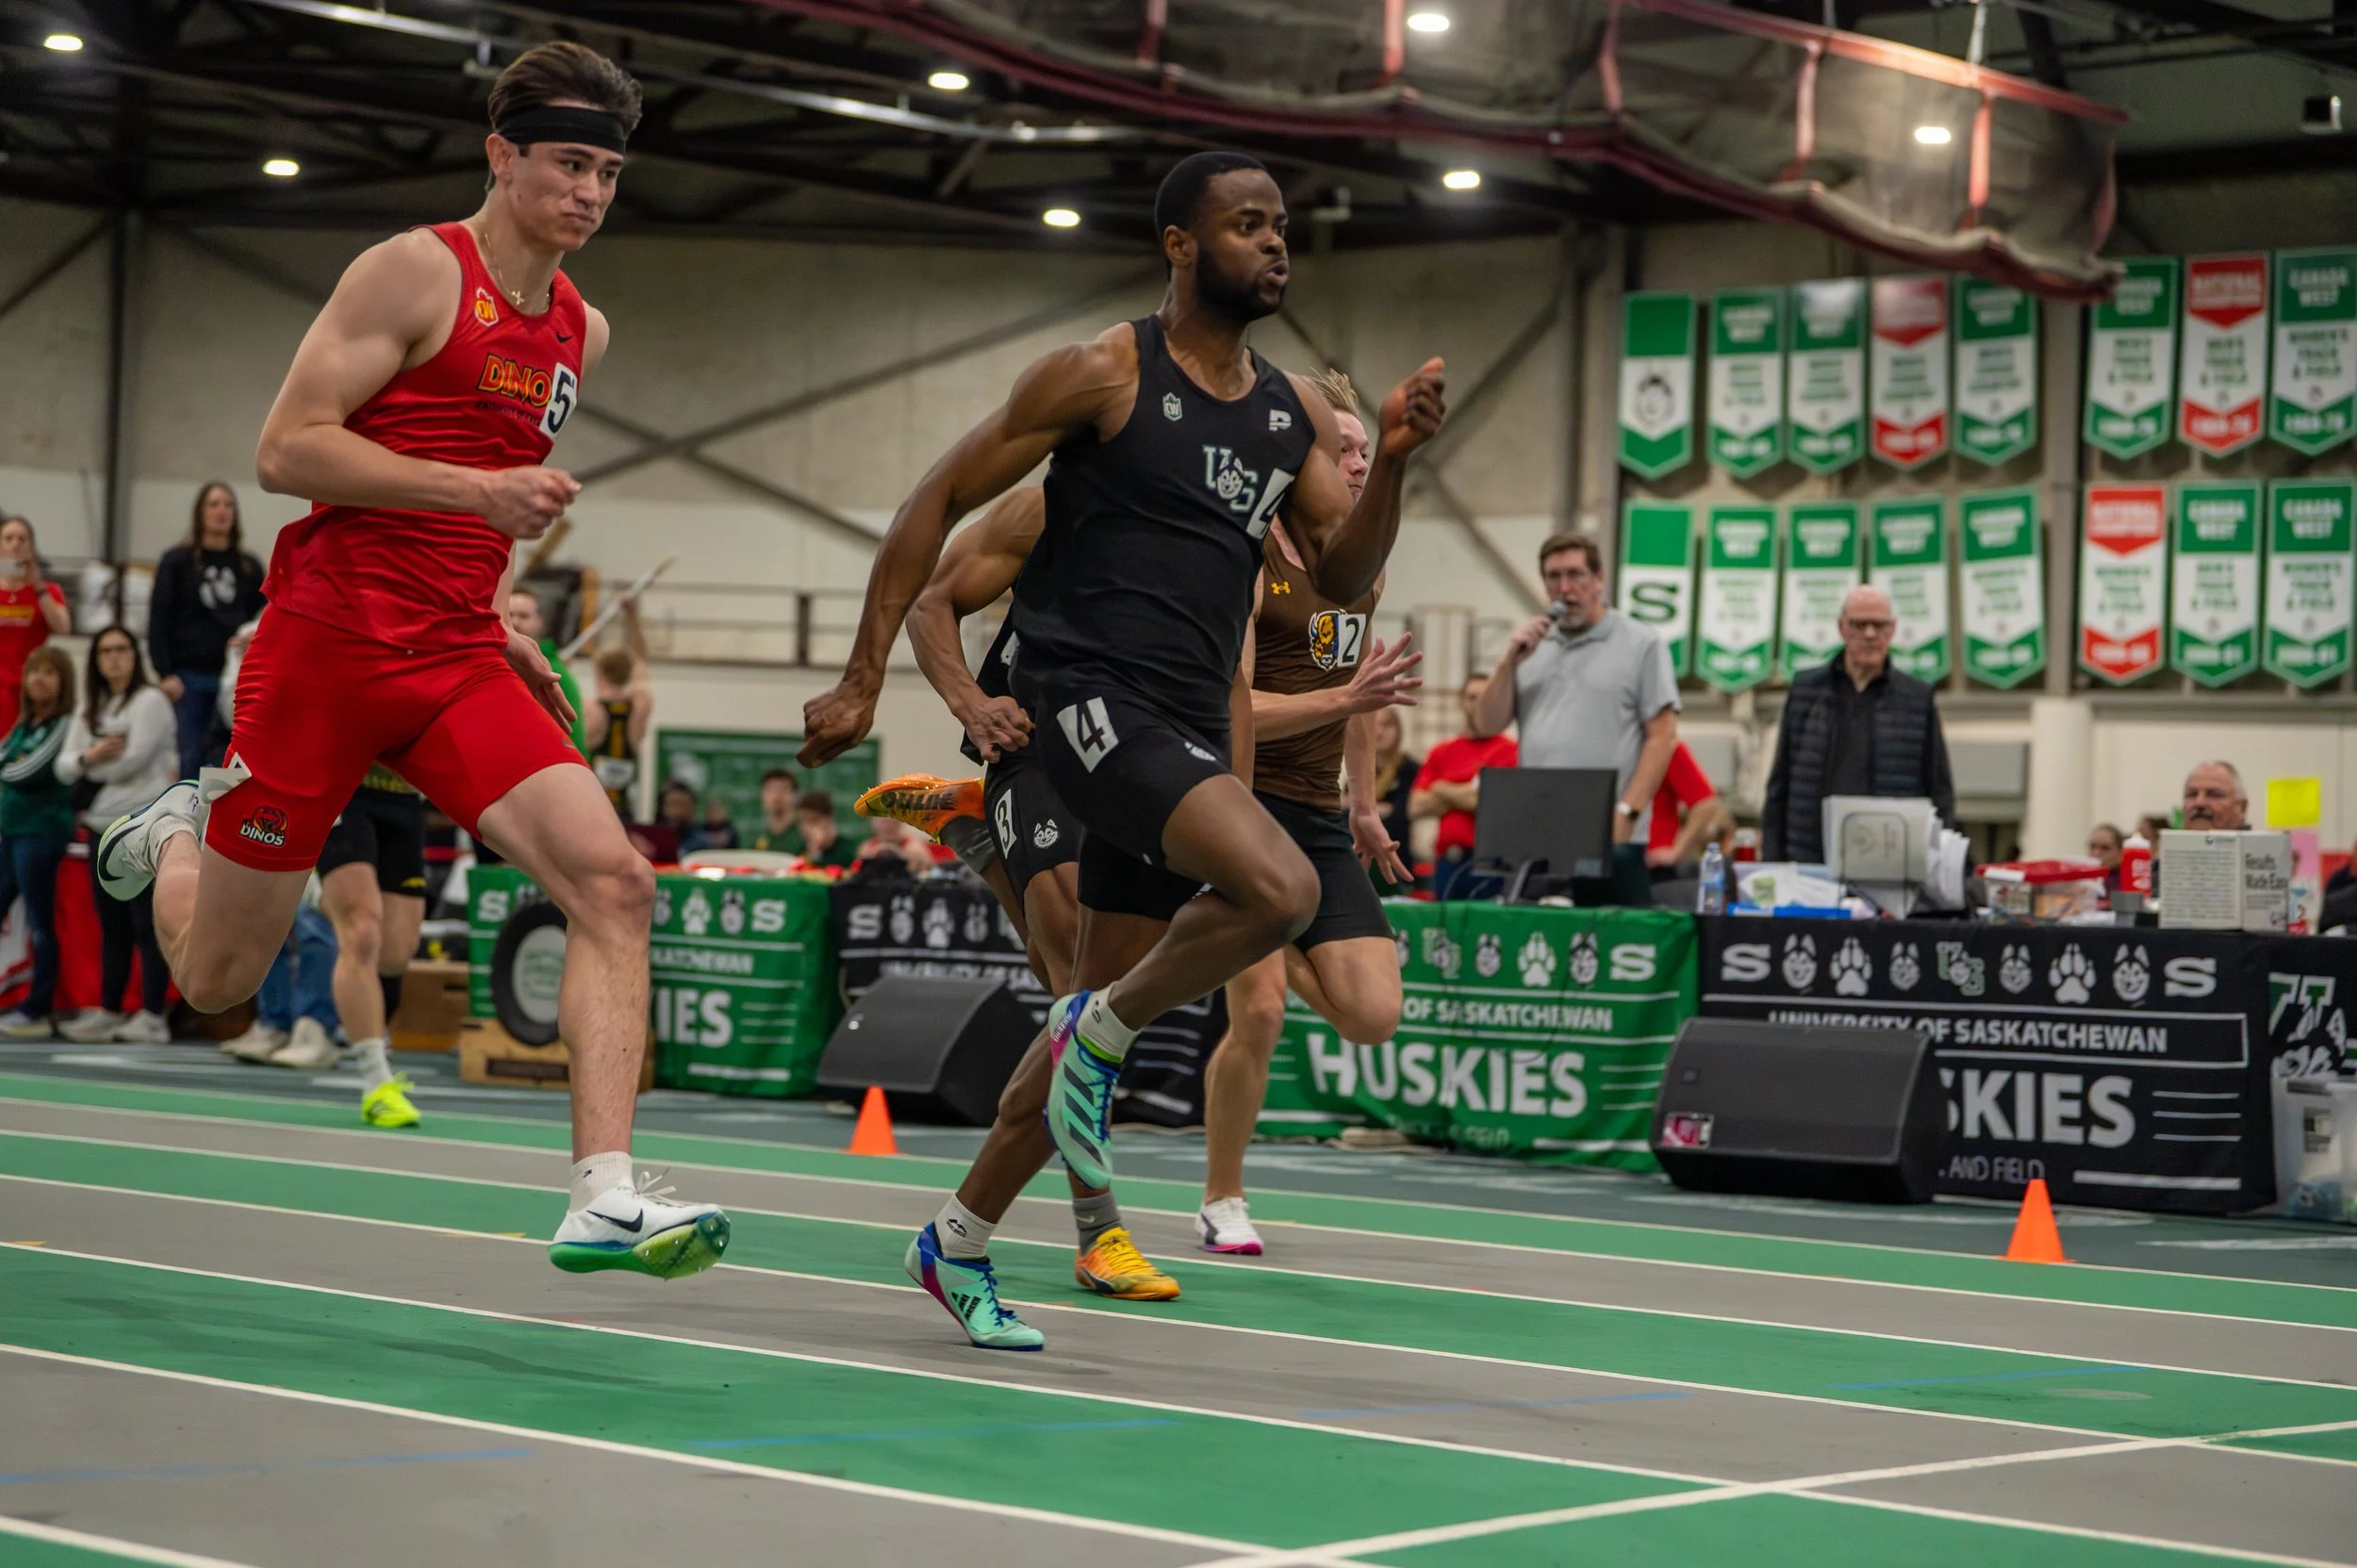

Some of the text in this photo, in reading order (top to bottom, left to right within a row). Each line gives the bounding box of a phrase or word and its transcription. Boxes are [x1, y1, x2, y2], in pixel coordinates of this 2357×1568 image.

[548, 371, 575, 434] 5
[1630, 582, 1680, 623] S
[1342, 618, 1360, 663] 2
[1076, 700, 1106, 753] 4
[239, 823, 285, 847] DINOS
[997, 799, 1011, 843] 3
[477, 890, 509, 922] S
[751, 900, 787, 933] S
[848, 904, 883, 940] S
[1609, 944, 1656, 982] S
[1721, 944, 1772, 982] S
[2164, 957, 2217, 998] S
[1403, 996, 1613, 1032] OF SASKATCHEWAN
[1915, 1017, 1952, 1044] OF
[1954, 1018, 2167, 1053] SASKATCHEWAN
[1307, 1032, 1589, 1119] HUSKIES
[1939, 1067, 2137, 1148] KIES
